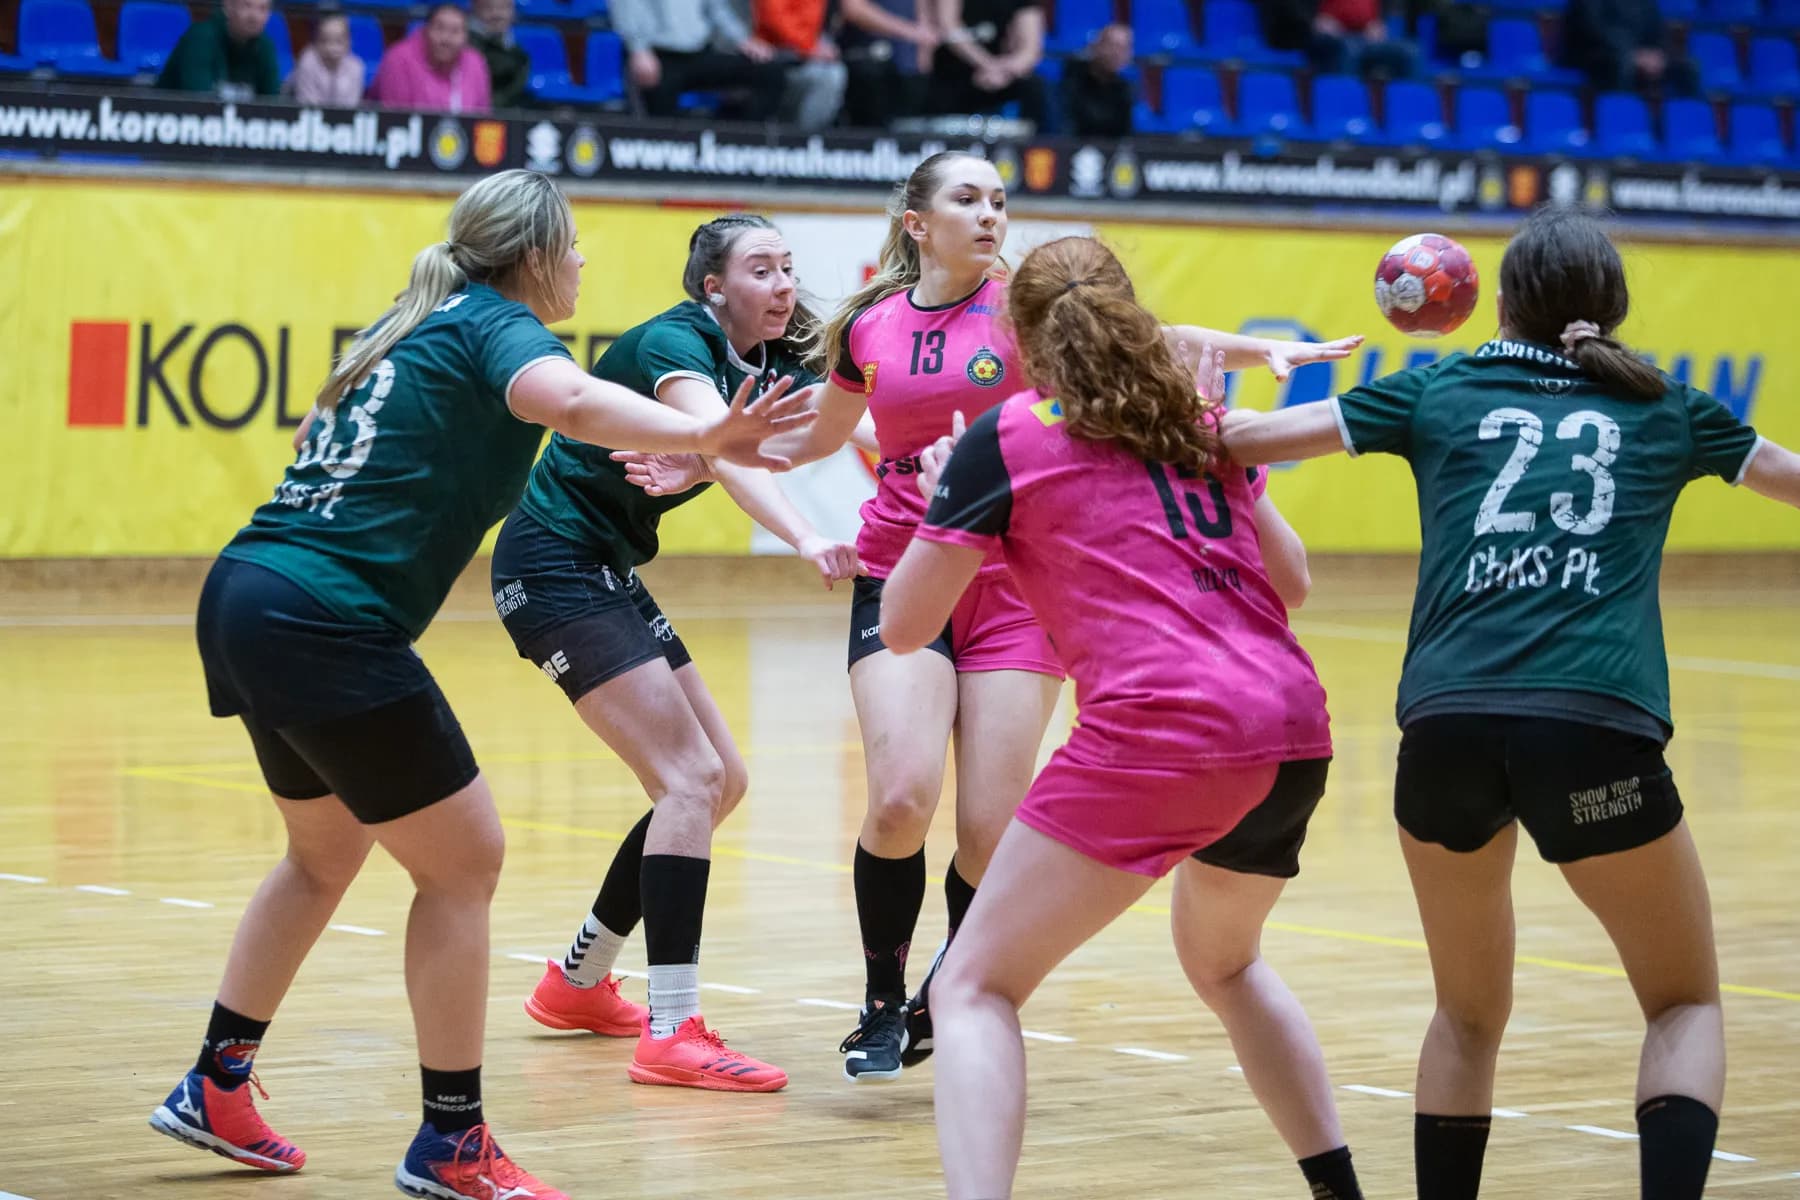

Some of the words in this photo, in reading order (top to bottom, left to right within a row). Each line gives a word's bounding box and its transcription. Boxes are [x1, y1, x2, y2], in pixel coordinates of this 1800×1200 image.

[0, 96, 423, 169] www.koronahandball.pl
[909, 330, 946, 376] 13
[1474, 407, 1621, 536] 23
[1143, 459, 1233, 539] 15
[504, 579, 524, 598] YOUR
[861, 624, 881, 640] kar
[542, 649, 571, 682] RE
[1569, 785, 1607, 809] SHOW
[1609, 775, 1640, 798] YOUR
[1572, 791, 1643, 825] STRENGTH
